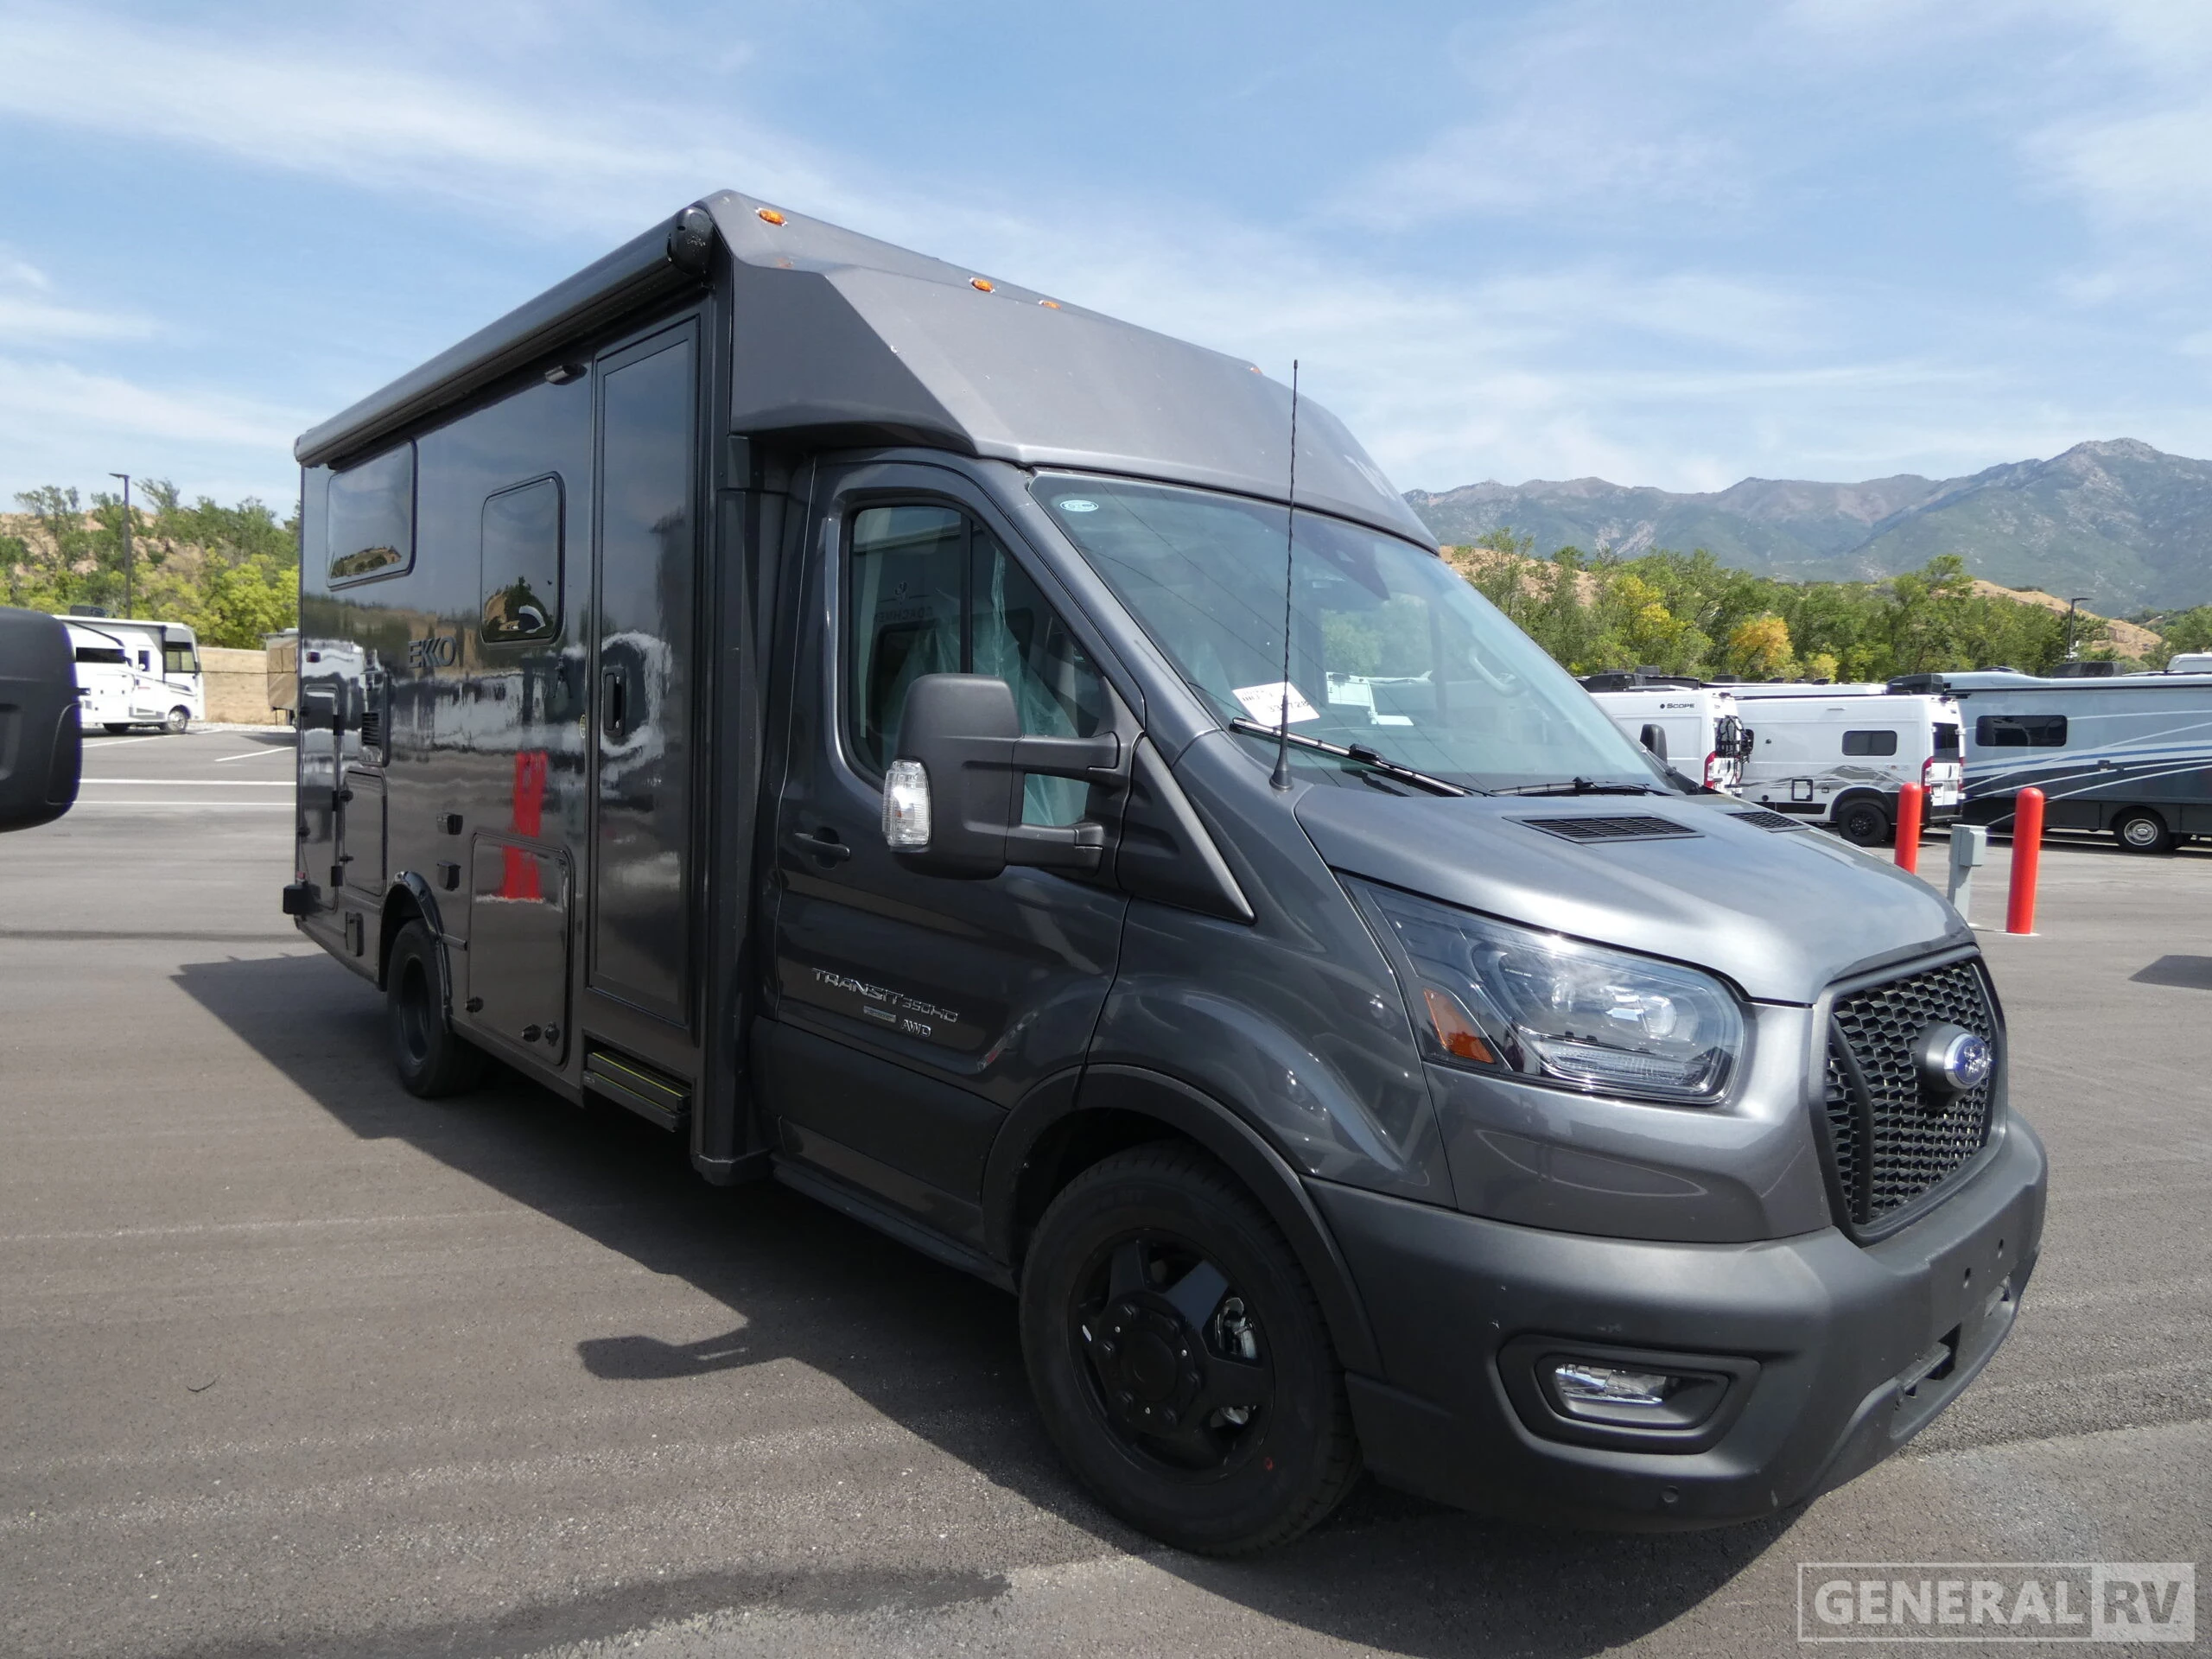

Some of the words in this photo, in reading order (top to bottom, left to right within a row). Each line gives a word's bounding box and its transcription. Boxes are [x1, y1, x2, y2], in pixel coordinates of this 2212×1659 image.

[408, 636, 457, 669] EKKO
[810, 967, 904, 1004] TRANSIT
[900, 1019, 931, 1038] AWD
